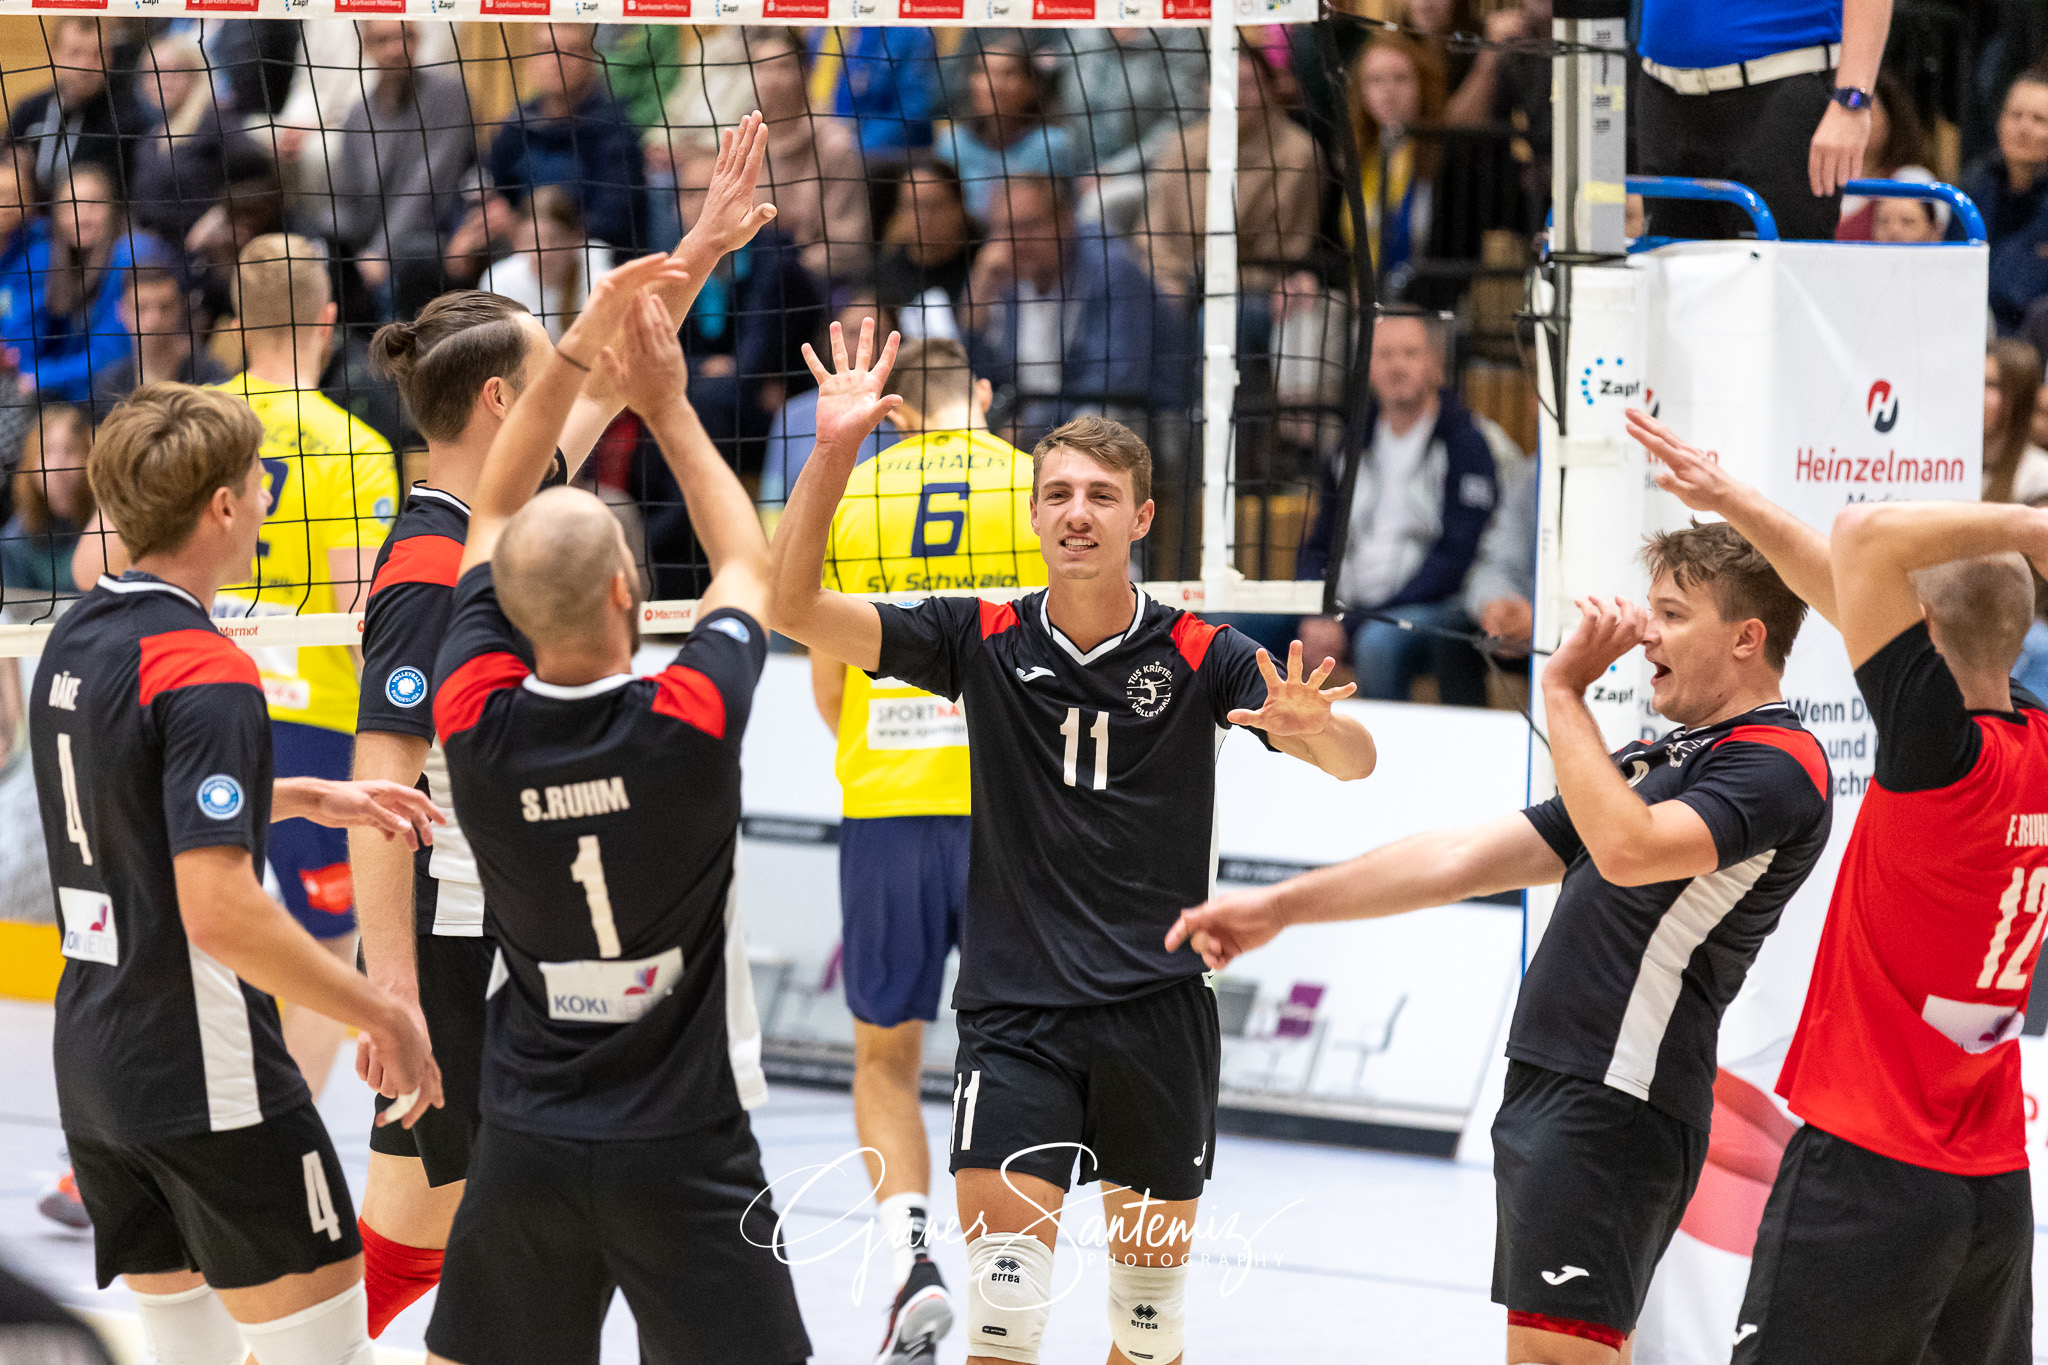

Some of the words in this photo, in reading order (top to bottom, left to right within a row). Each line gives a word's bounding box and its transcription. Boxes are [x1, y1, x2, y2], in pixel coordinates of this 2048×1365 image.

[438, 1, 456, 9] Zapf
[1600, 379, 1640, 398] Zapf
[1796, 447, 1964, 483] Heinzelmann
[911, 482, 971, 557] 6
[391, 671, 423, 686] VOLLEYBALL
[1127, 668, 1142, 684] TUS
[1143, 662, 1173, 682] KRIFTEL
[1131, 692, 1172, 718] VOLLEYBALL
[1594, 687, 1633, 703] Zapf
[1059, 707, 1110, 790] 11
[1828, 733, 1866, 759] und
[58, 732, 94, 866] 4
[520, 775, 631, 823] S.RUHM
[570, 834, 622, 958] 1
[1977, 866, 2048, 989] 12
[302, 1150, 343, 1242] 4
